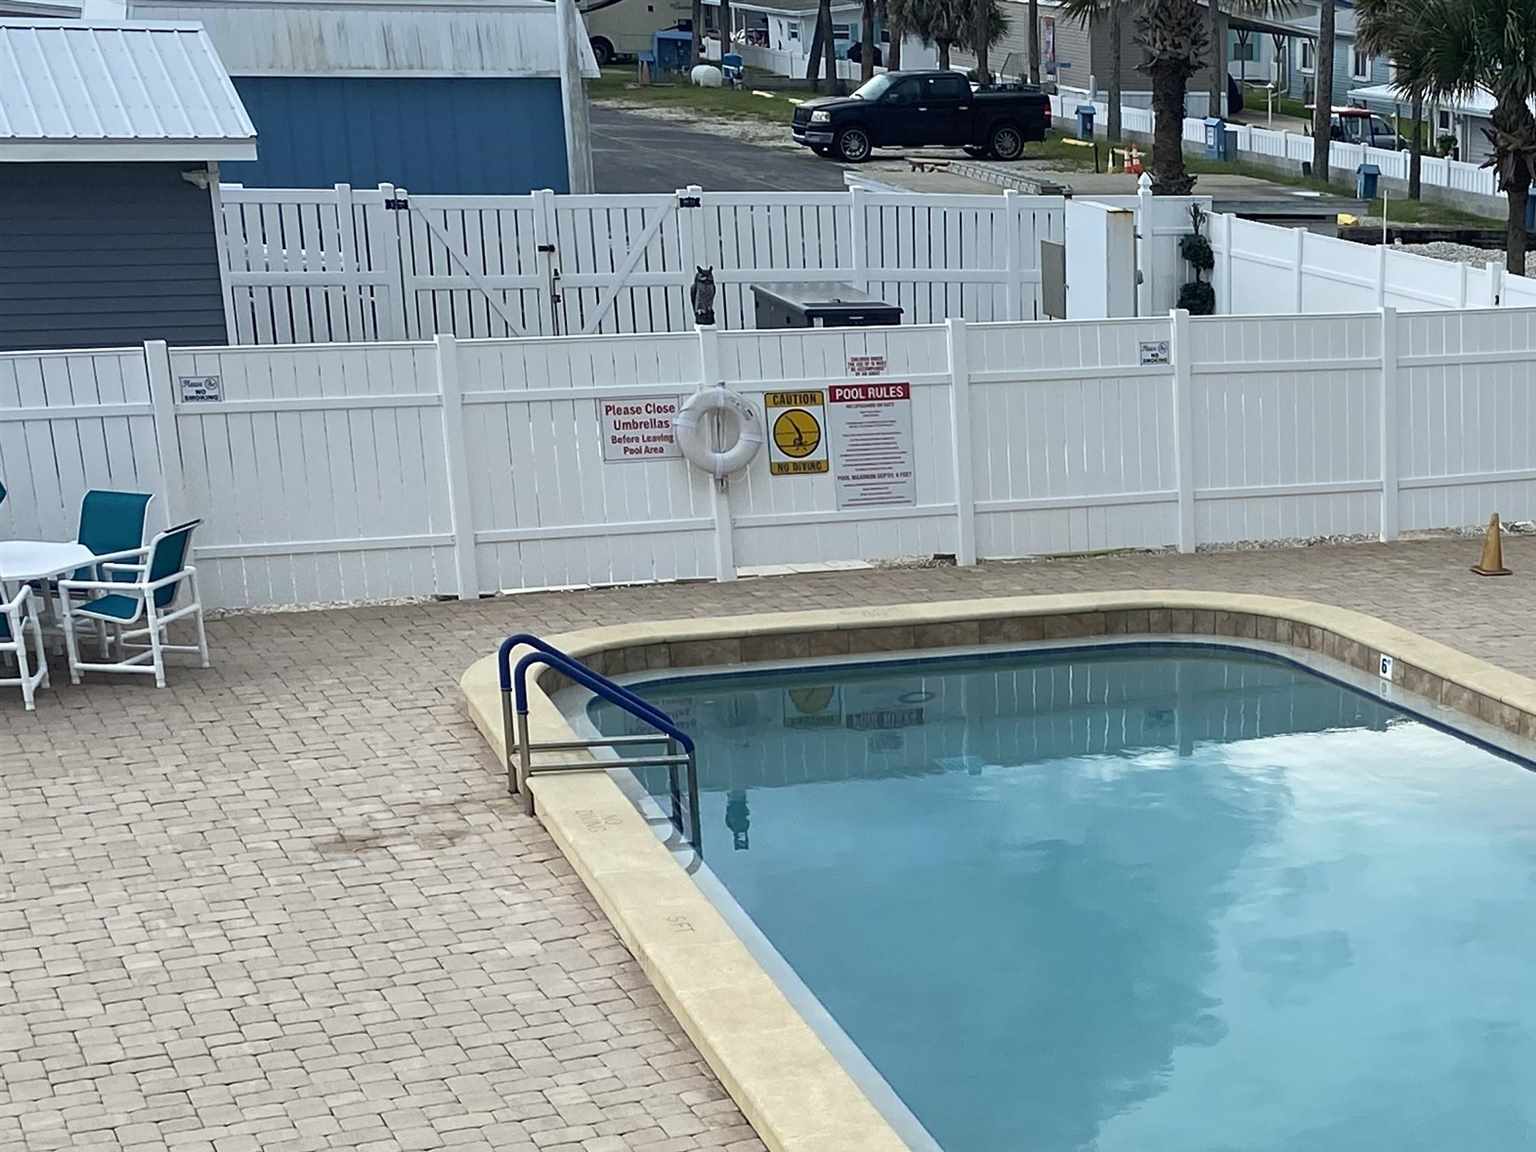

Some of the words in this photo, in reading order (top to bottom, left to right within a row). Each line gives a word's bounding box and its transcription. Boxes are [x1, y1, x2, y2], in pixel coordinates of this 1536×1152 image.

[772, 392, 817, 406] CAUTION
[835, 387, 866, 401] POOL
[867, 385, 904, 399] RULES
[605, 404, 642, 416] Please
[644, 402, 676, 415] Close
[613, 417, 671, 431] Umbrellas
[611, 434, 640, 445] Before
[641, 433, 674, 444] Leaving
[623, 446, 643, 456] Pool
[643, 445, 664, 455] Area
[777, 462, 791, 472] NO
[792, 460, 823, 472] DIVING
[1381, 657, 1388, 674] 6
